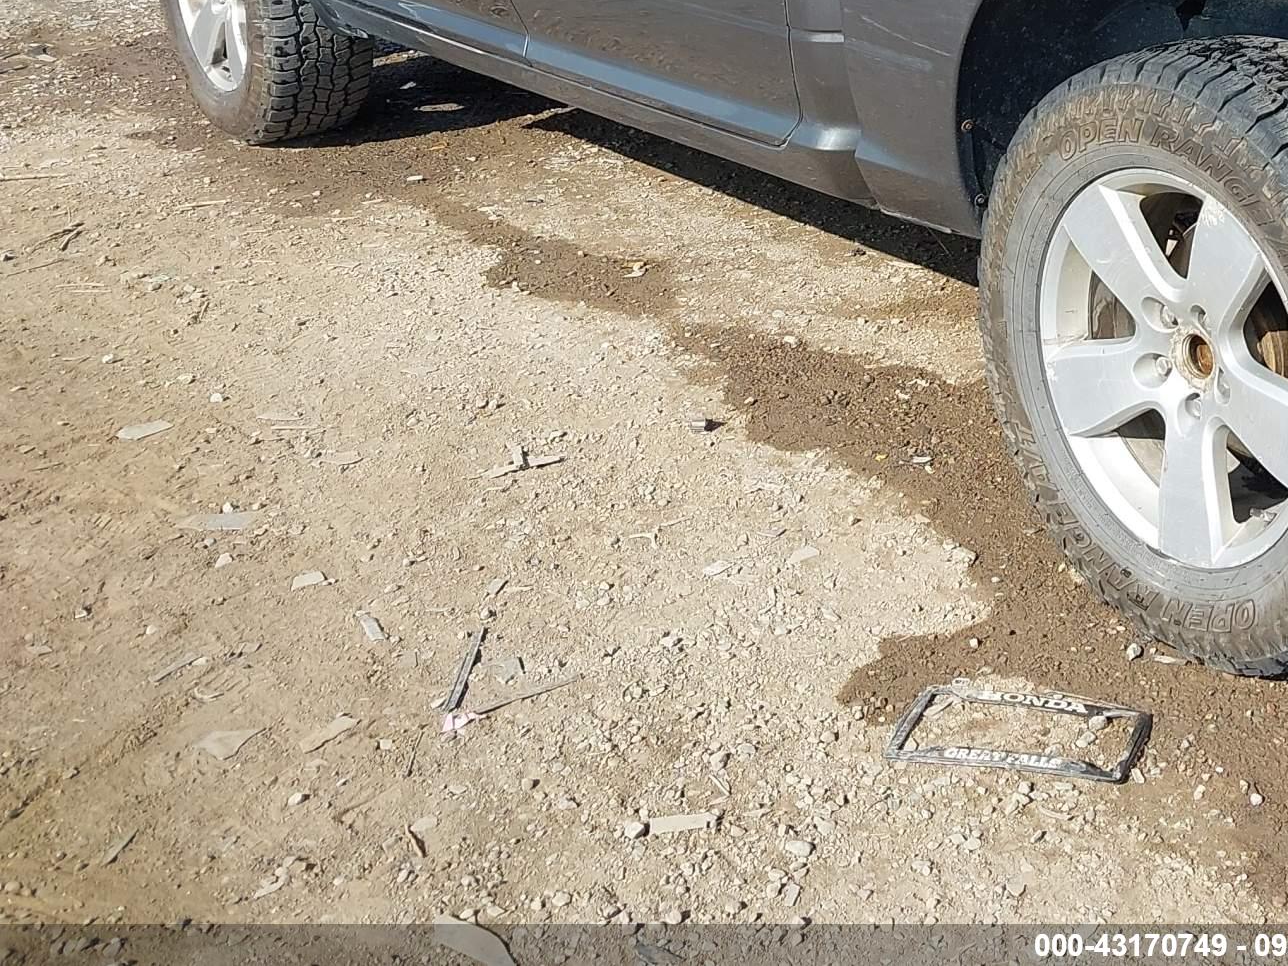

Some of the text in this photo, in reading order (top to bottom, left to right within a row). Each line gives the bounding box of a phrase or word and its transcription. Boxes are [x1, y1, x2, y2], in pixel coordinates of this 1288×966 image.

[1058, 118, 1143, 161] OPEN
[1151, 124, 1276, 227] RANGE
[1052, 499, 1160, 611] RANGE
[1160, 599, 1256, 633] OPEN
[980, 691, 1088, 714] HONDA
[944, 748, 1062, 769] GREAT FALLS
